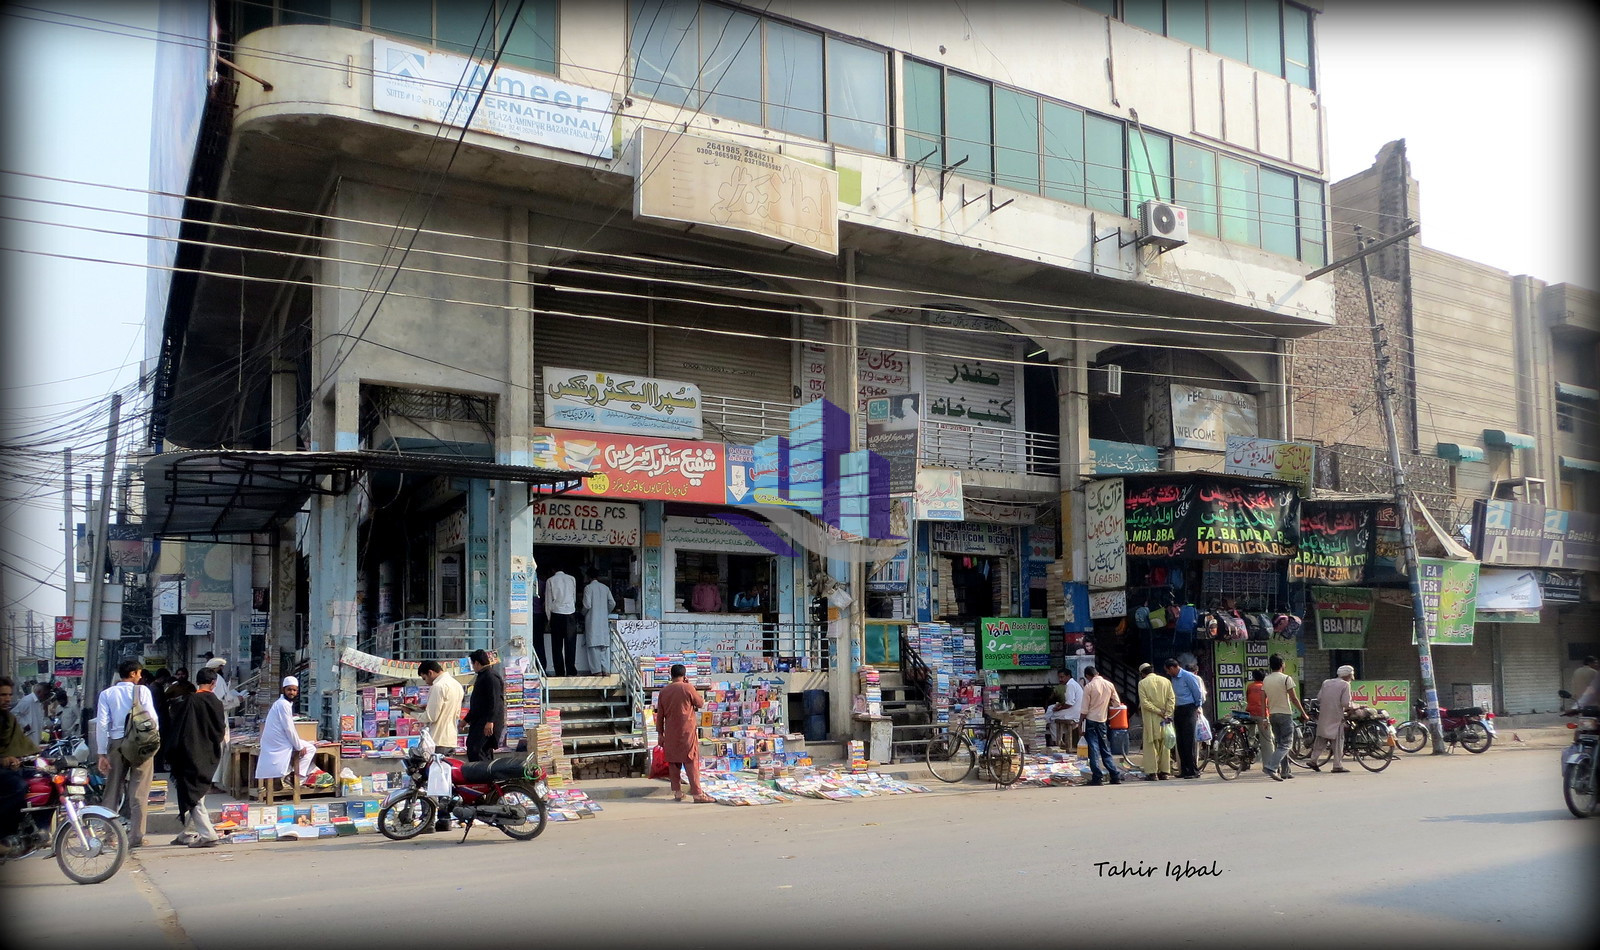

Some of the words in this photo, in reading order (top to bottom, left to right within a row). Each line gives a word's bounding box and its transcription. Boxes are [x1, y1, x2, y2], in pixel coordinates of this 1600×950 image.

[466, 64, 589, 113] Ameer
[450, 89, 602, 133] INTERNATIONAL
[945, 361, 1000, 386] صفدر
[966, 398, 1013, 427] کتب
[1175, 425, 1216, 441] WELCOME
[590, 483, 606, 491] 1953
[1485, 528, 1504, 536] Double
[1511, 526, 1535, 537] Double
[1426, 565, 1437, 577] F.A
[1423, 580, 1438, 592] F.Sc
[1323, 618, 1343, 632] BBA
[1219, 664, 1241, 674] BBA
[1219, 678, 1243, 688] MBA
